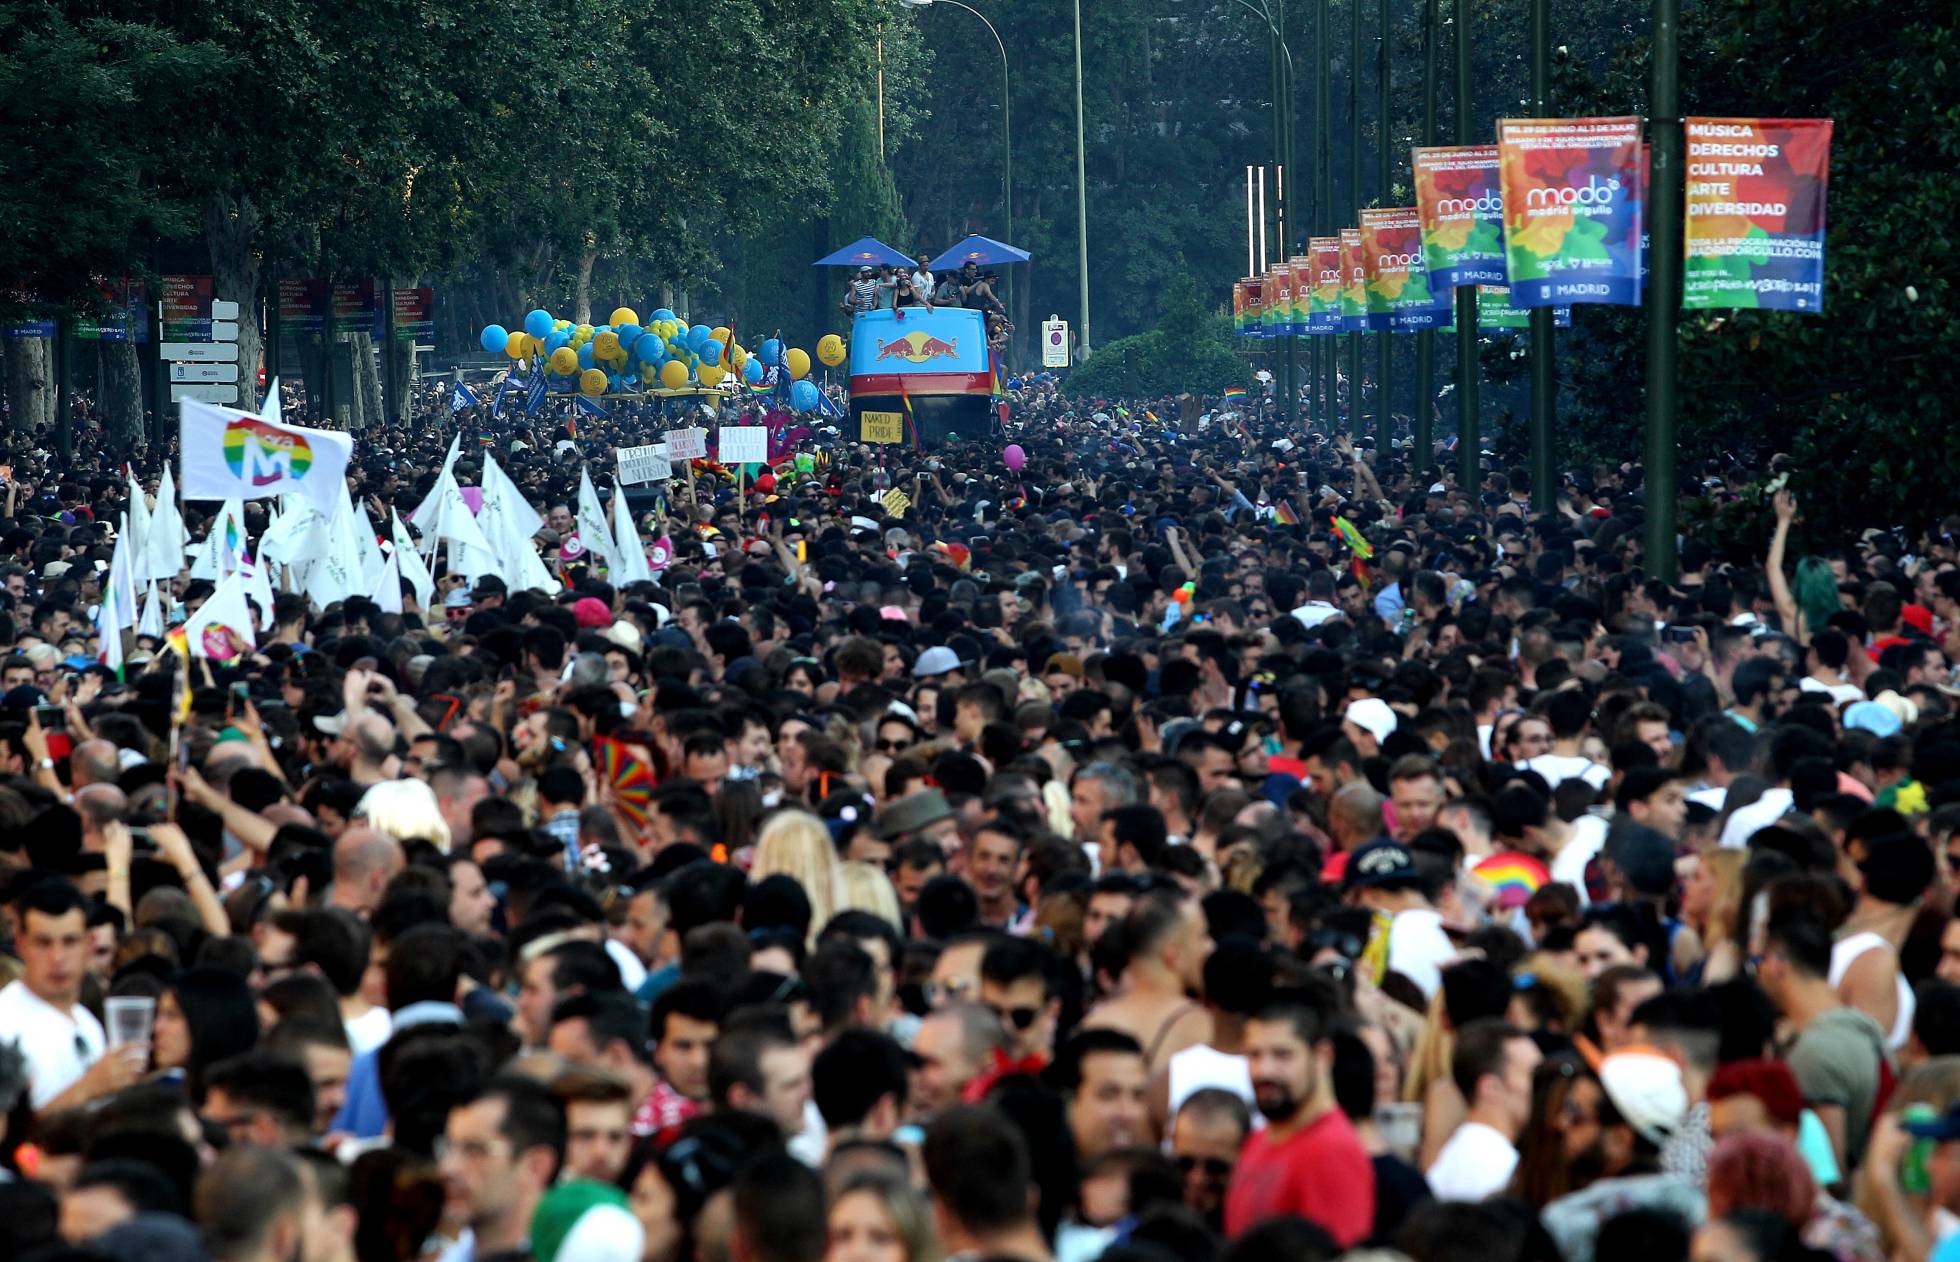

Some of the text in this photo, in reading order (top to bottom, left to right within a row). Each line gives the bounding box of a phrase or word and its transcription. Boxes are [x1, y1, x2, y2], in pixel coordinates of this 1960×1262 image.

[1689, 123, 1753, 137] MÚSICA
[1689, 143, 1779, 157] DERECHOS
[1689, 163, 1764, 176] CULTURA
[1689, 183, 1730, 195] ARTE
[1528, 205, 1613, 217] madrid orgullo
[1689, 202, 1787, 216] DIVERSIDAD
[1439, 212, 1471, 221] madrid
[1810, 240, 1822, 249] EN
[1688, 246, 1822, 259] MADRIDORGULLO.COM
[1464, 271, 1503, 280] MADRID
[1557, 284, 1610, 296] MADRID
[1400, 316, 1433, 324] MADRID
[864, 413, 891, 425] NAKED
[869, 424, 893, 439] PRIDE
